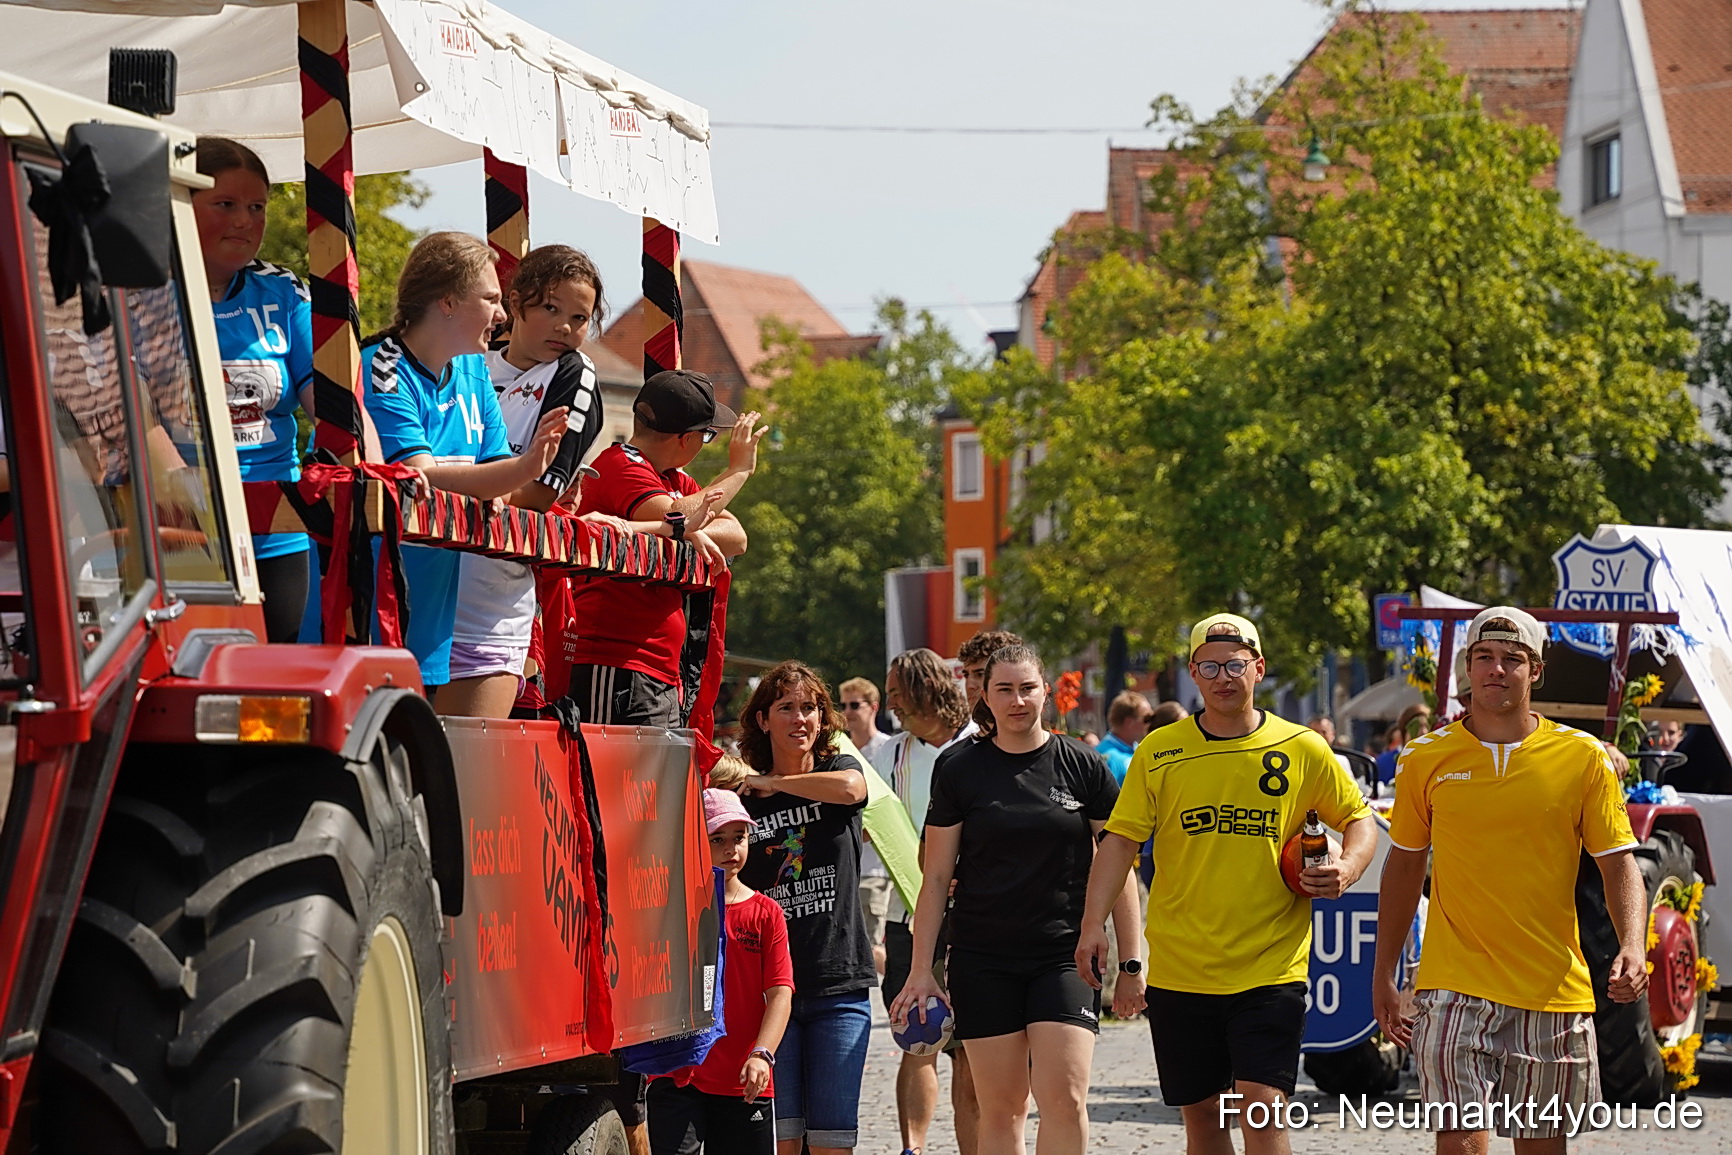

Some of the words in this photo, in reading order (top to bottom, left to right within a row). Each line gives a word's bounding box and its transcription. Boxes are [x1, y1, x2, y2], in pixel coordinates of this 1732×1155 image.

[213, 307, 243, 319] ummel
[246, 303, 288, 354] 15
[457, 392, 485, 444] 14
[1591, 558, 1626, 587] SV
[1152, 746, 1184, 760] Kempa
[1258, 750, 1291, 797] 8
[748, 801, 823, 835] EHEULT
[1218, 804, 1280, 823] Sport
[1217, 819, 1279, 838] Deals
[469, 818, 495, 877] Lass
[498, 815, 522, 874] dich
[808, 865, 827, 878] WENN
[827, 864, 836, 875] ES
[763, 882, 792, 900] STARK
[793, 873, 836, 897] BLUTET
[791, 891, 817, 906] KOMISCH
